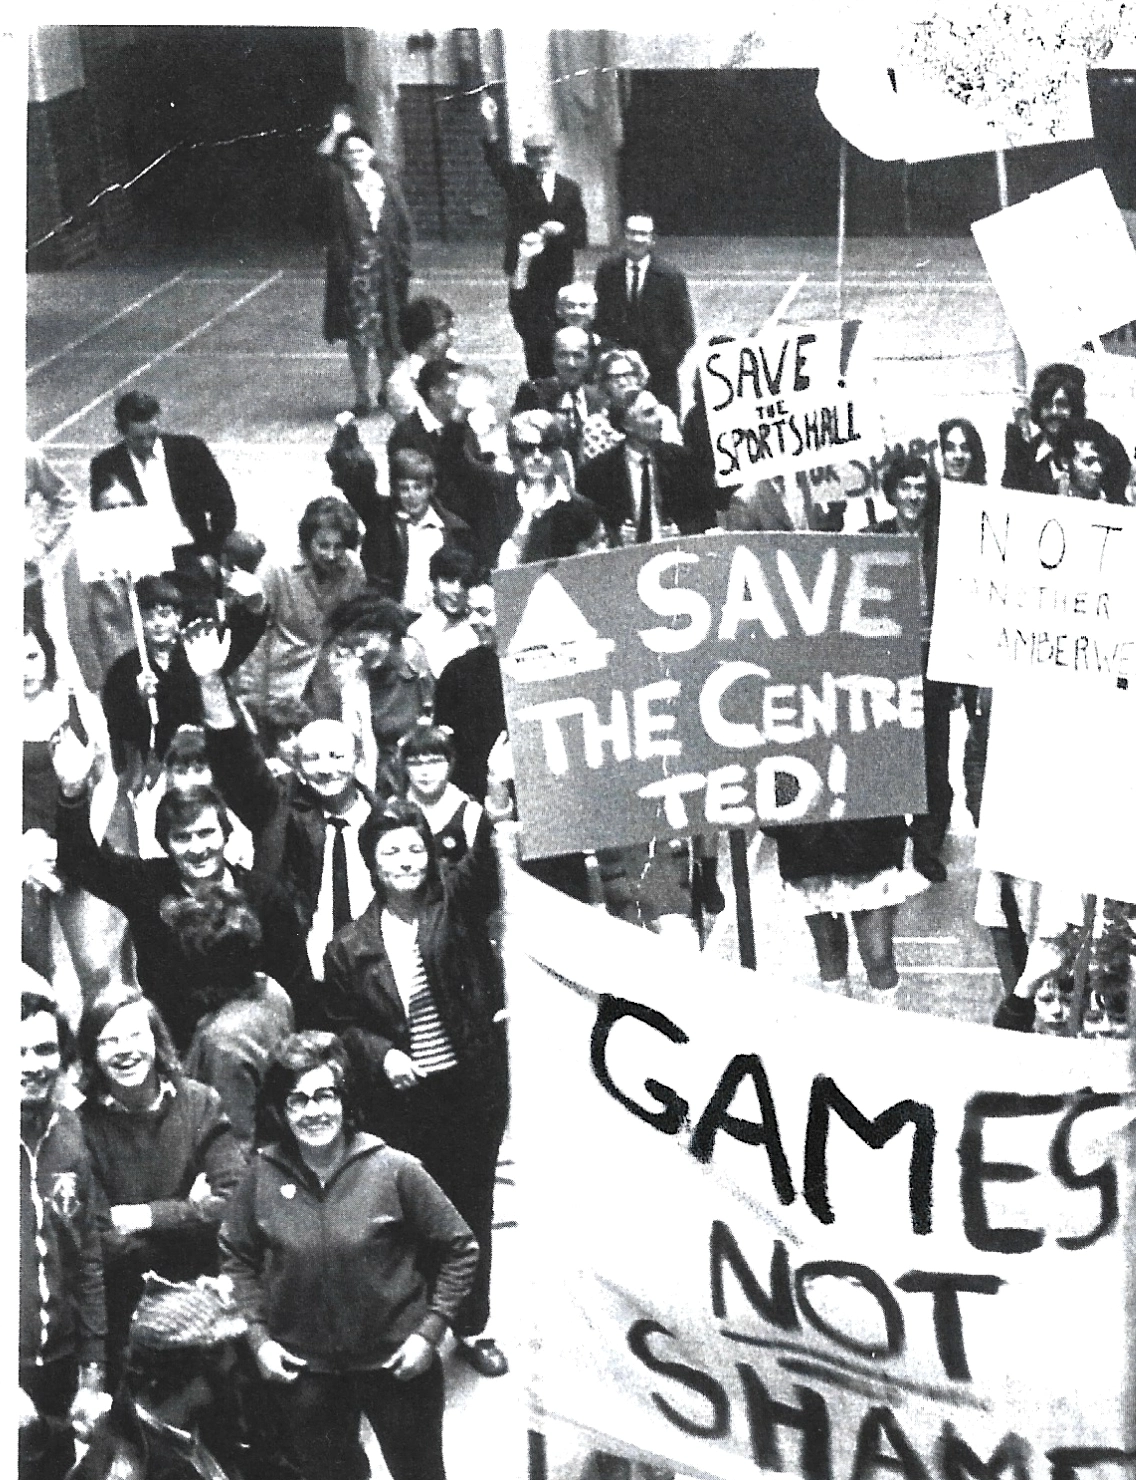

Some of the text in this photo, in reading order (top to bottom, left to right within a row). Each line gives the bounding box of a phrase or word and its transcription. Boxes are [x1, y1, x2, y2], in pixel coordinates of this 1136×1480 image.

[717, 401, 862, 476] SPORTSHALL
[756, 400, 790, 420] THE
[980, 510, 1123, 573] NOT
[636, 545, 913, 654] SAVE
[960, 577, 1110, 620] NTHER
[513, 660, 925, 776] THE CENTRE
[637, 744, 848, 829] TED!
[709, 1219, 1004, 1382] NOT
